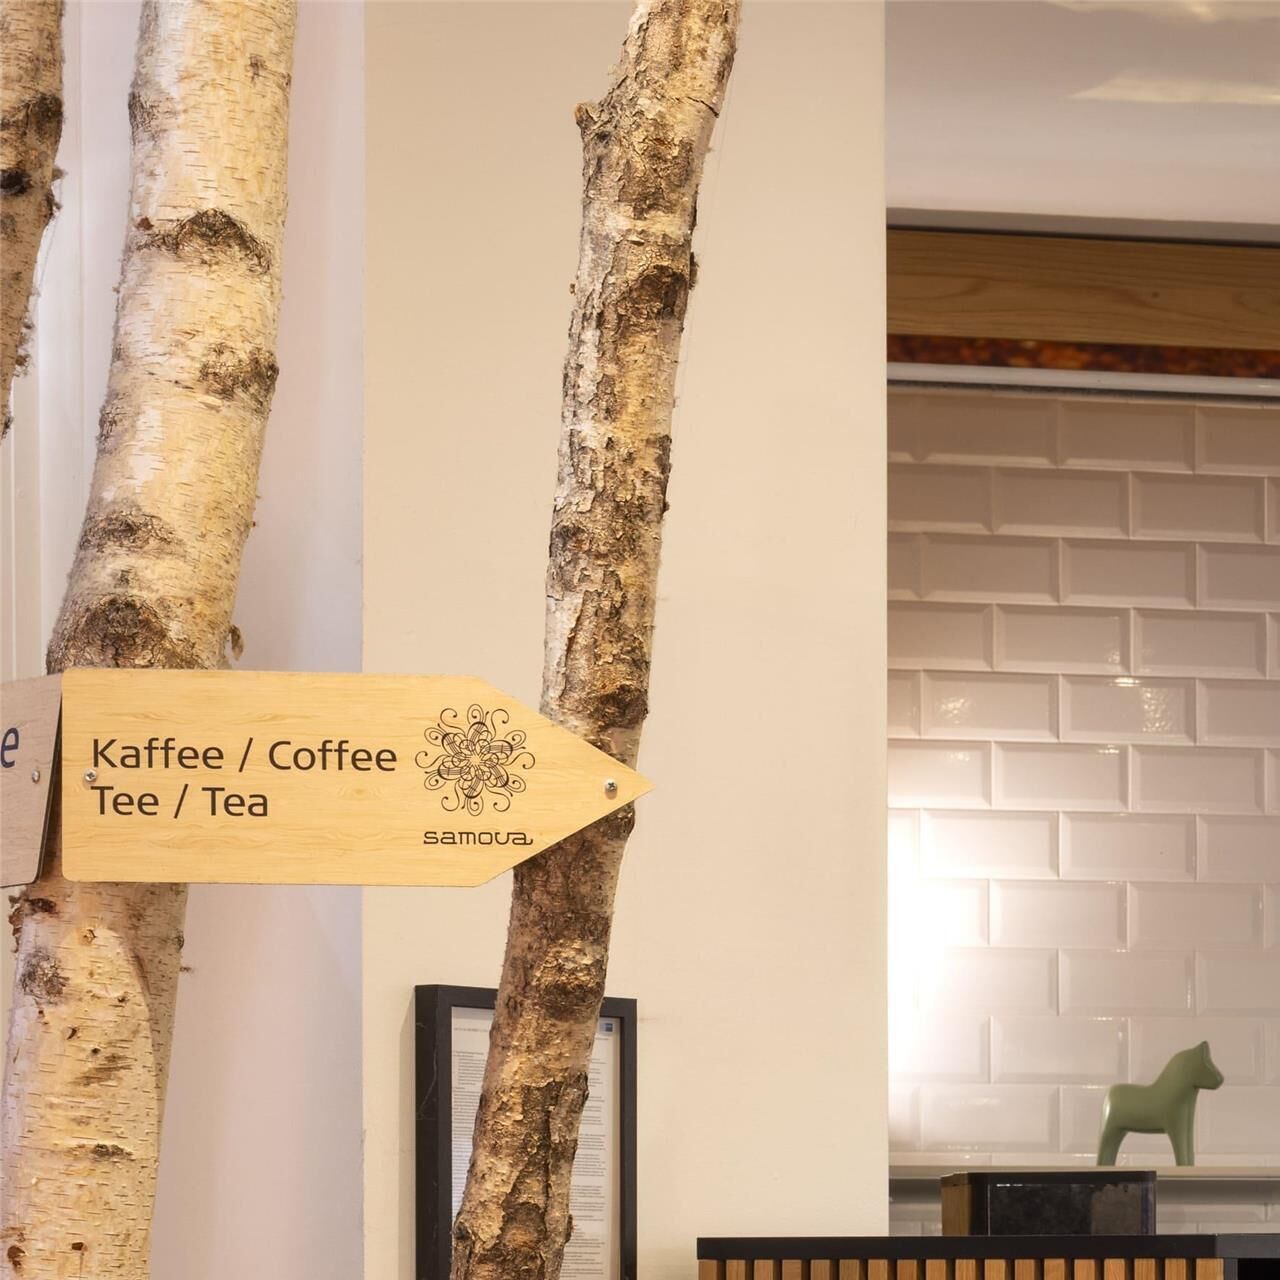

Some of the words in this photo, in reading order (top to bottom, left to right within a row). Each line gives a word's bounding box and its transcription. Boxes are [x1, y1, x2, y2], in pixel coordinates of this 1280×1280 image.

[92, 738, 225, 770] Kaffee
[239, 738, 254, 773] /
[268, 739, 397, 771] Coffee
[91, 785, 160, 816] Tee
[174, 784, 189, 819] /
[201, 786, 268, 817] Tea
[423, 831, 534, 846] samova
